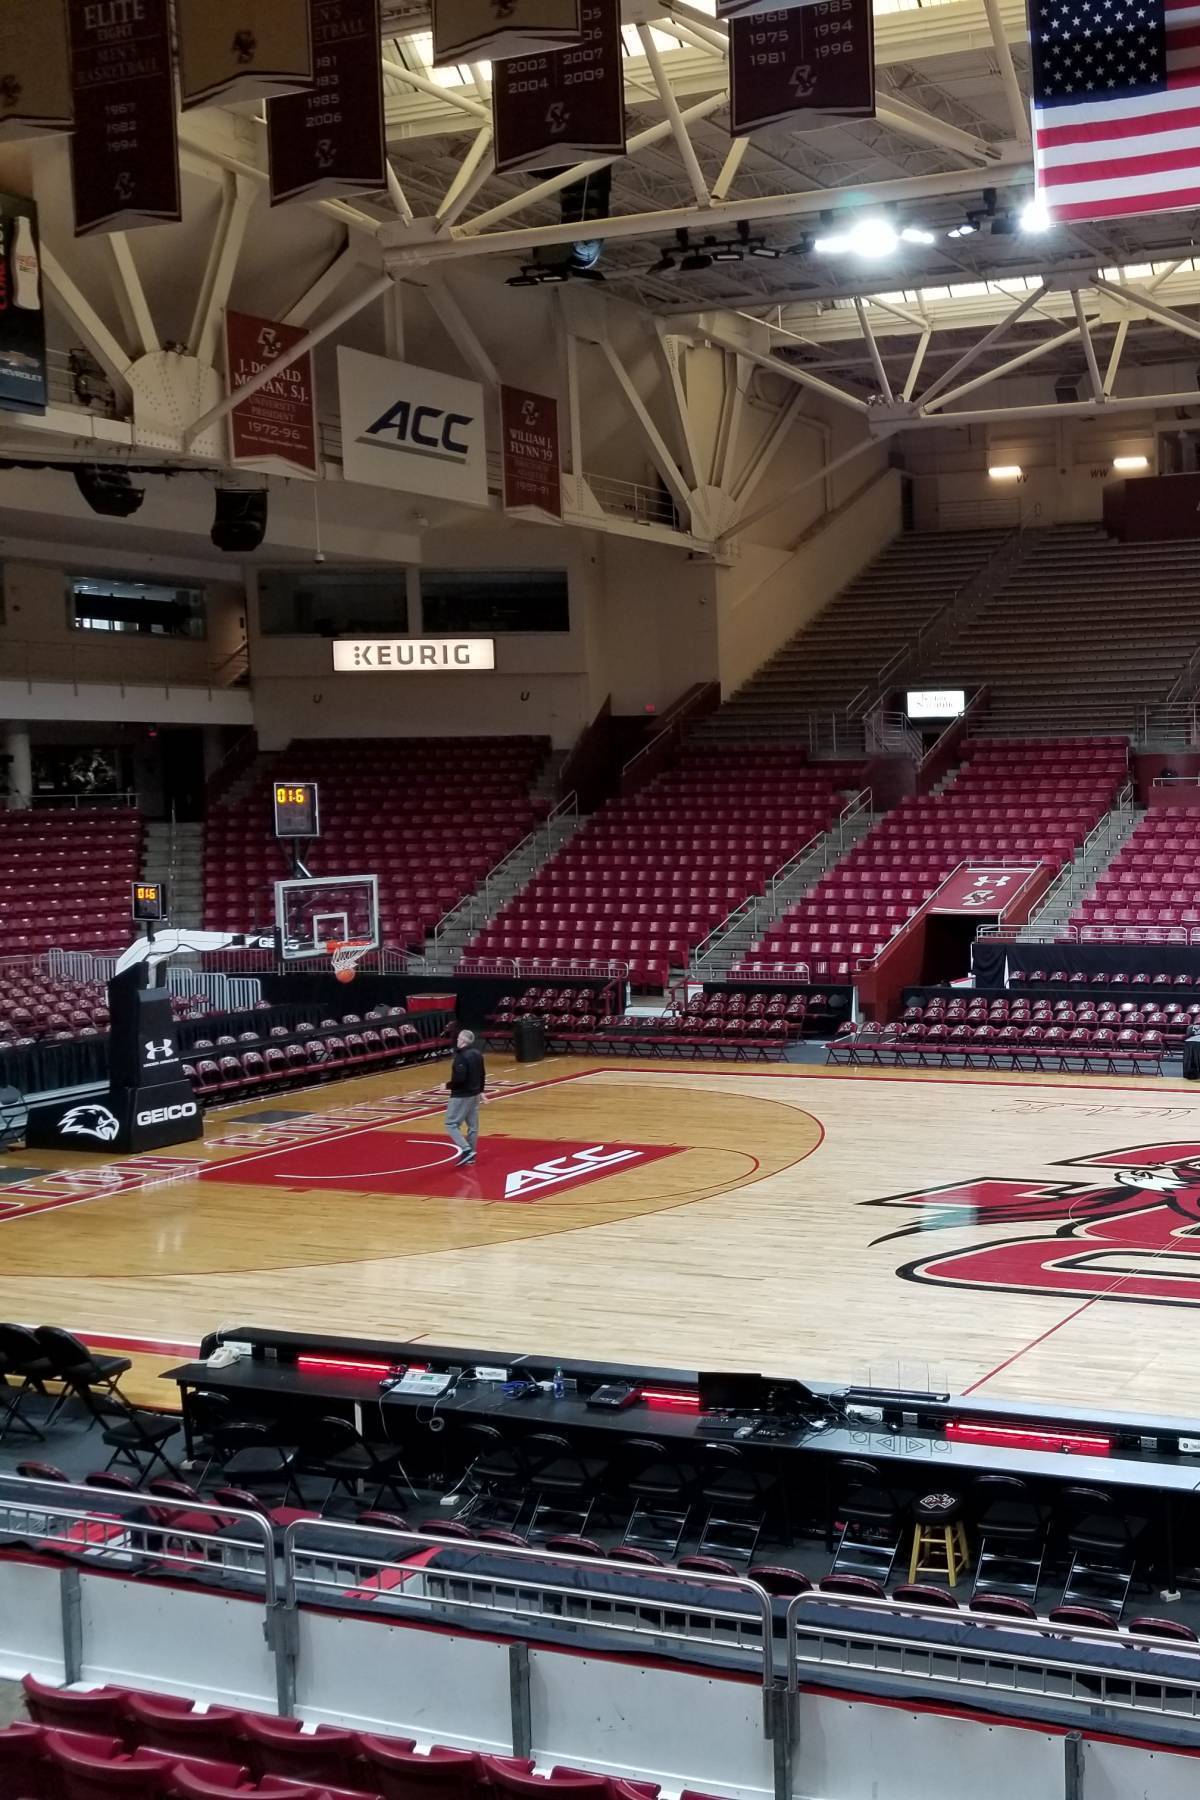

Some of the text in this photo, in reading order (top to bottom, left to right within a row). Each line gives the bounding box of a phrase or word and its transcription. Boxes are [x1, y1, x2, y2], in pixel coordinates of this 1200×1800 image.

[84, 0, 145, 30] ELITE
[813, 0, 852, 16] 1985
[750, 30, 789, 45] 1975
[814, 20, 854, 38] 1994
[563, 47, 603, 64] 2007
[814, 40, 854, 59] 1996
[507, 58, 548, 74] 2002
[750, 52, 786, 66] 1981
[564, 68, 605, 85] 2009
[508, 78, 549, 94] 2004
[305, 112, 343, 127] 2006
[248, 421, 301, 440] 1972-96
[364, 400, 475, 454] ACC
[354, 644, 471, 666] KEURIG
[137, 1102, 197, 1126] GEICO
[505, 1145, 636, 1194] ACC
